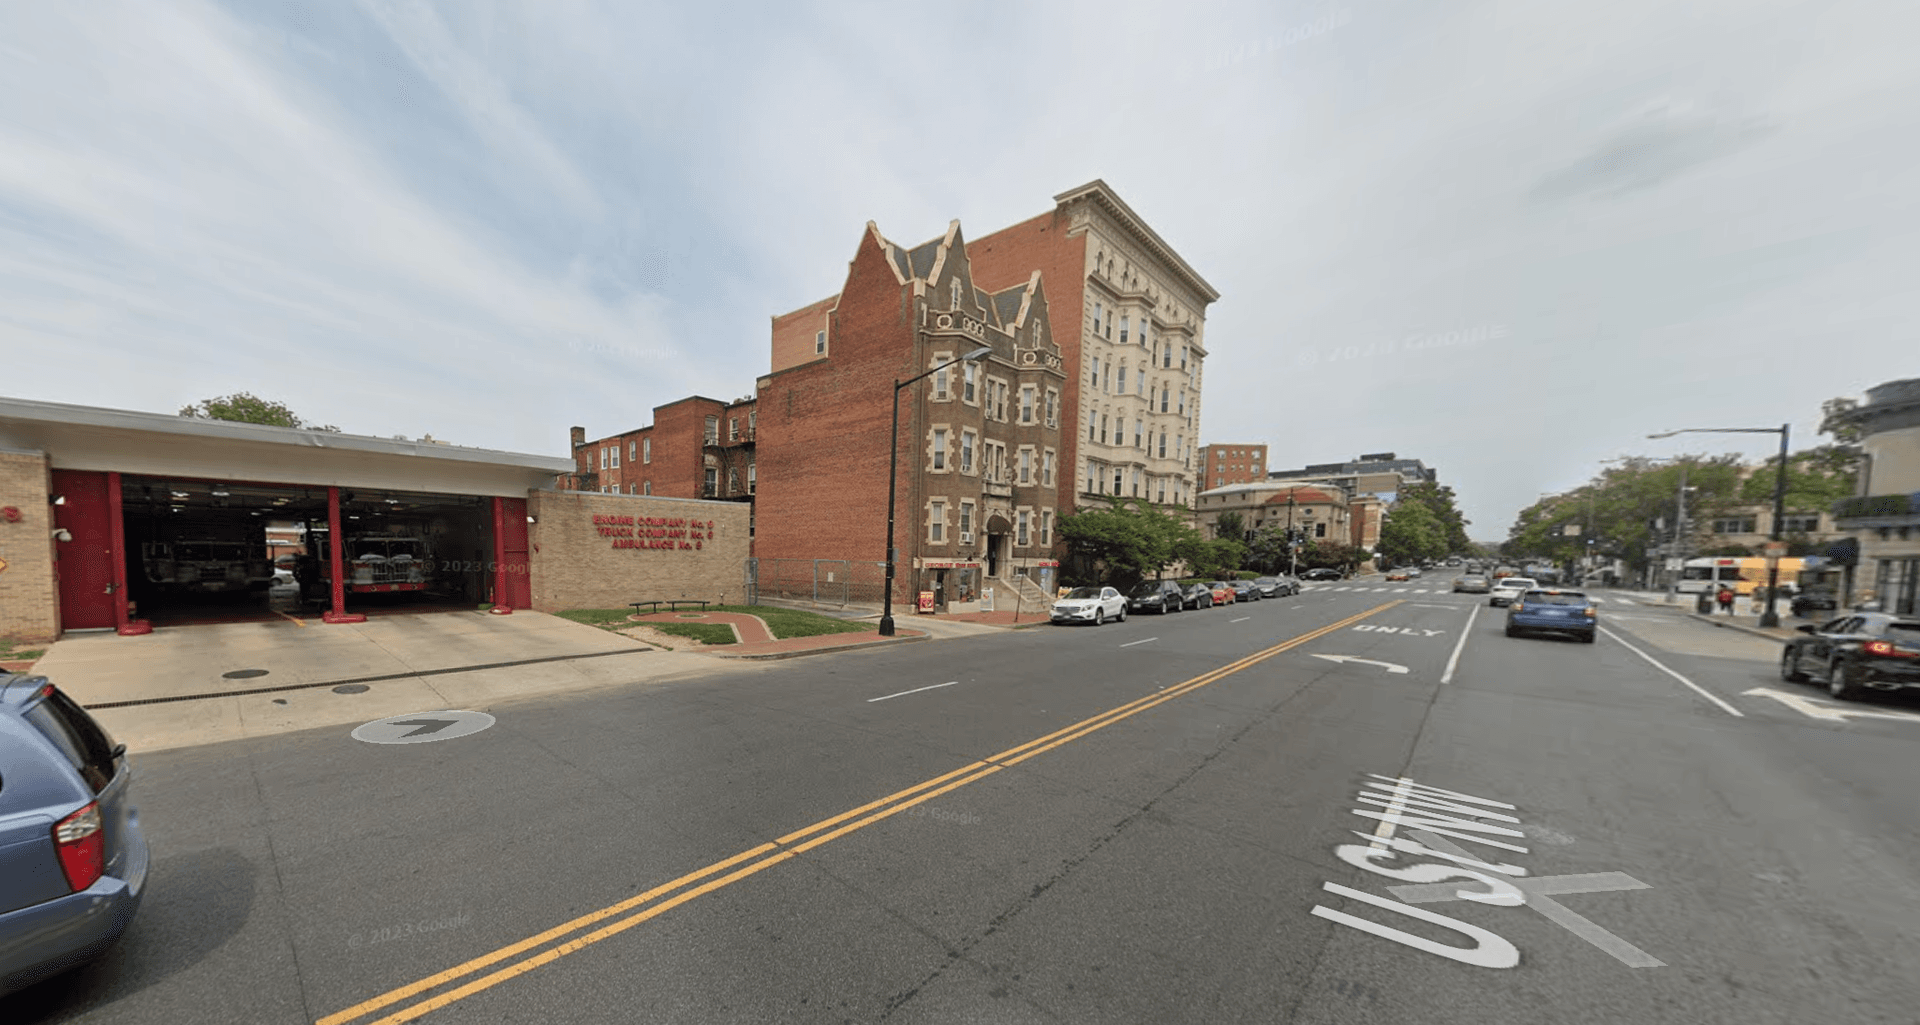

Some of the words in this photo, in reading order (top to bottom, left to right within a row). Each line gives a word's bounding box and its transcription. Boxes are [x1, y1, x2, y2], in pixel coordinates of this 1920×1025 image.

[593, 514, 634, 526] ENGINE
[637, 516, 686, 528] COMPANY
[597, 527, 633, 538] TRUCK
[638, 528, 687, 538] COMPANY
[612, 539, 675, 550] AMBULANCE
[1352, 625, 1446, 637] ONLY
